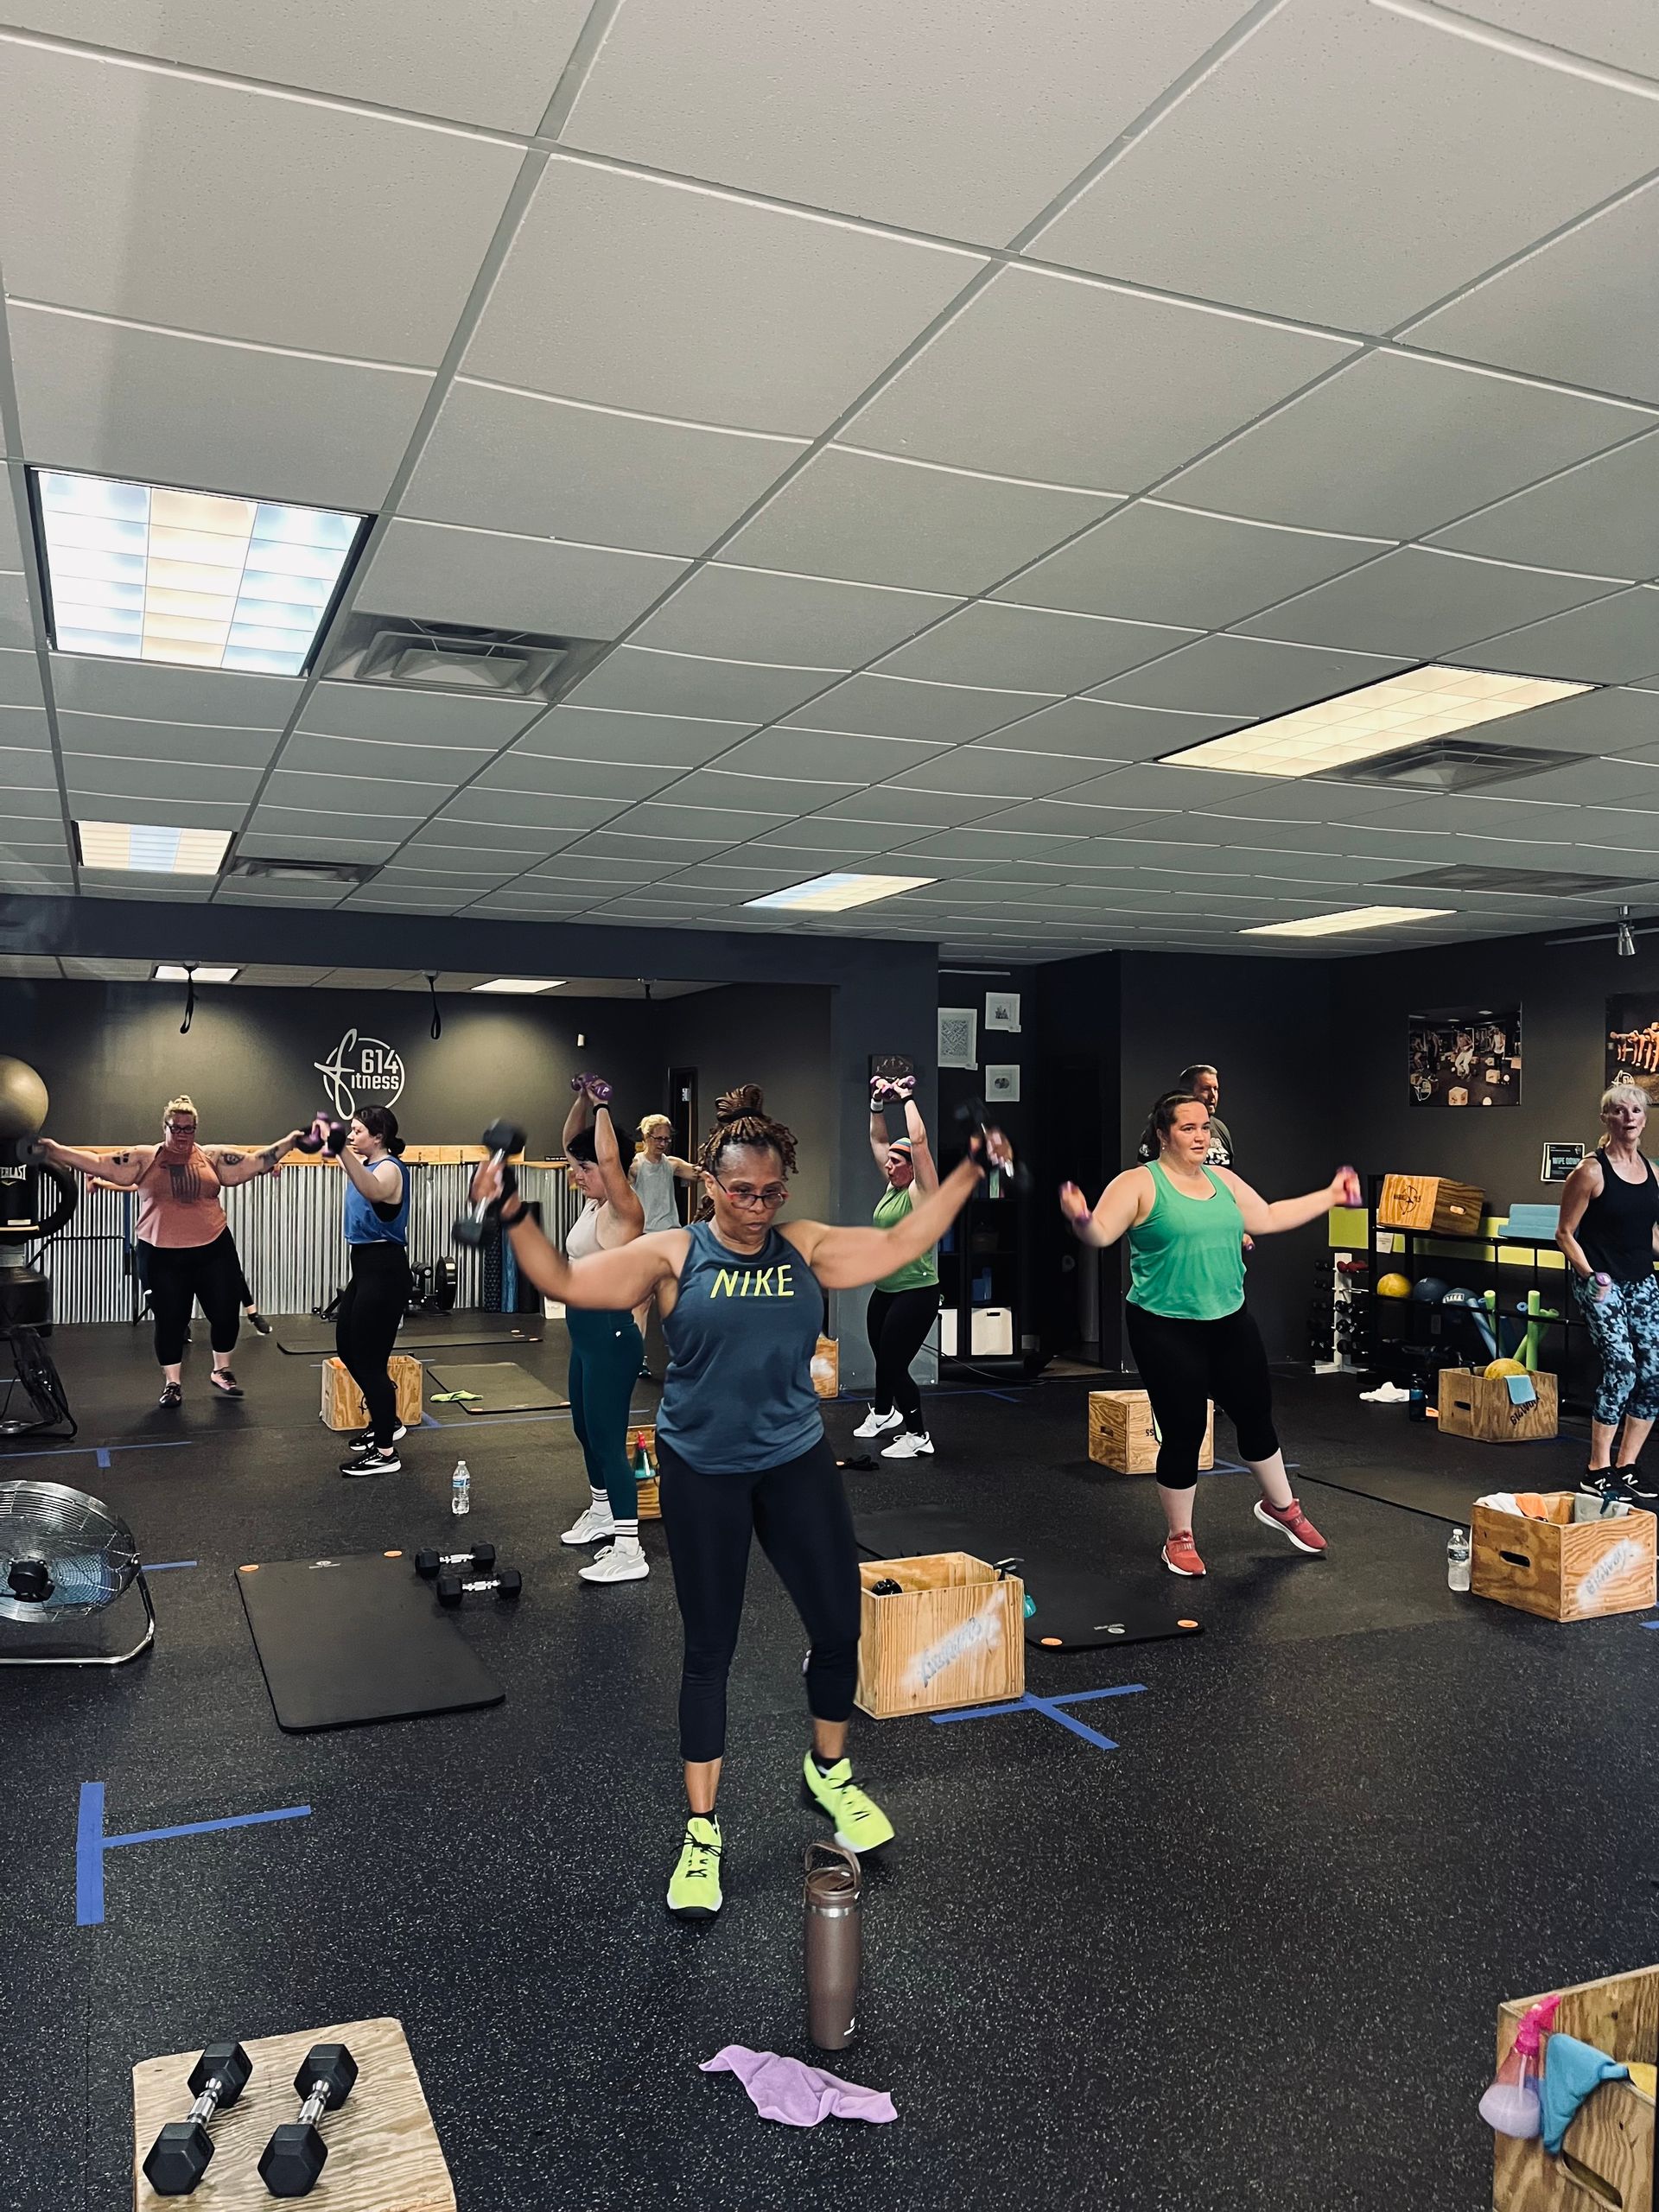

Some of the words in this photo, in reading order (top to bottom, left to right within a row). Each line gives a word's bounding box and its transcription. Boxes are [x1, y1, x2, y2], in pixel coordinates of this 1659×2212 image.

[361, 1049, 399, 1074] 614
[0, 1164, 27, 1180] ERLAST
[709, 1264, 795, 1299] NIKE
